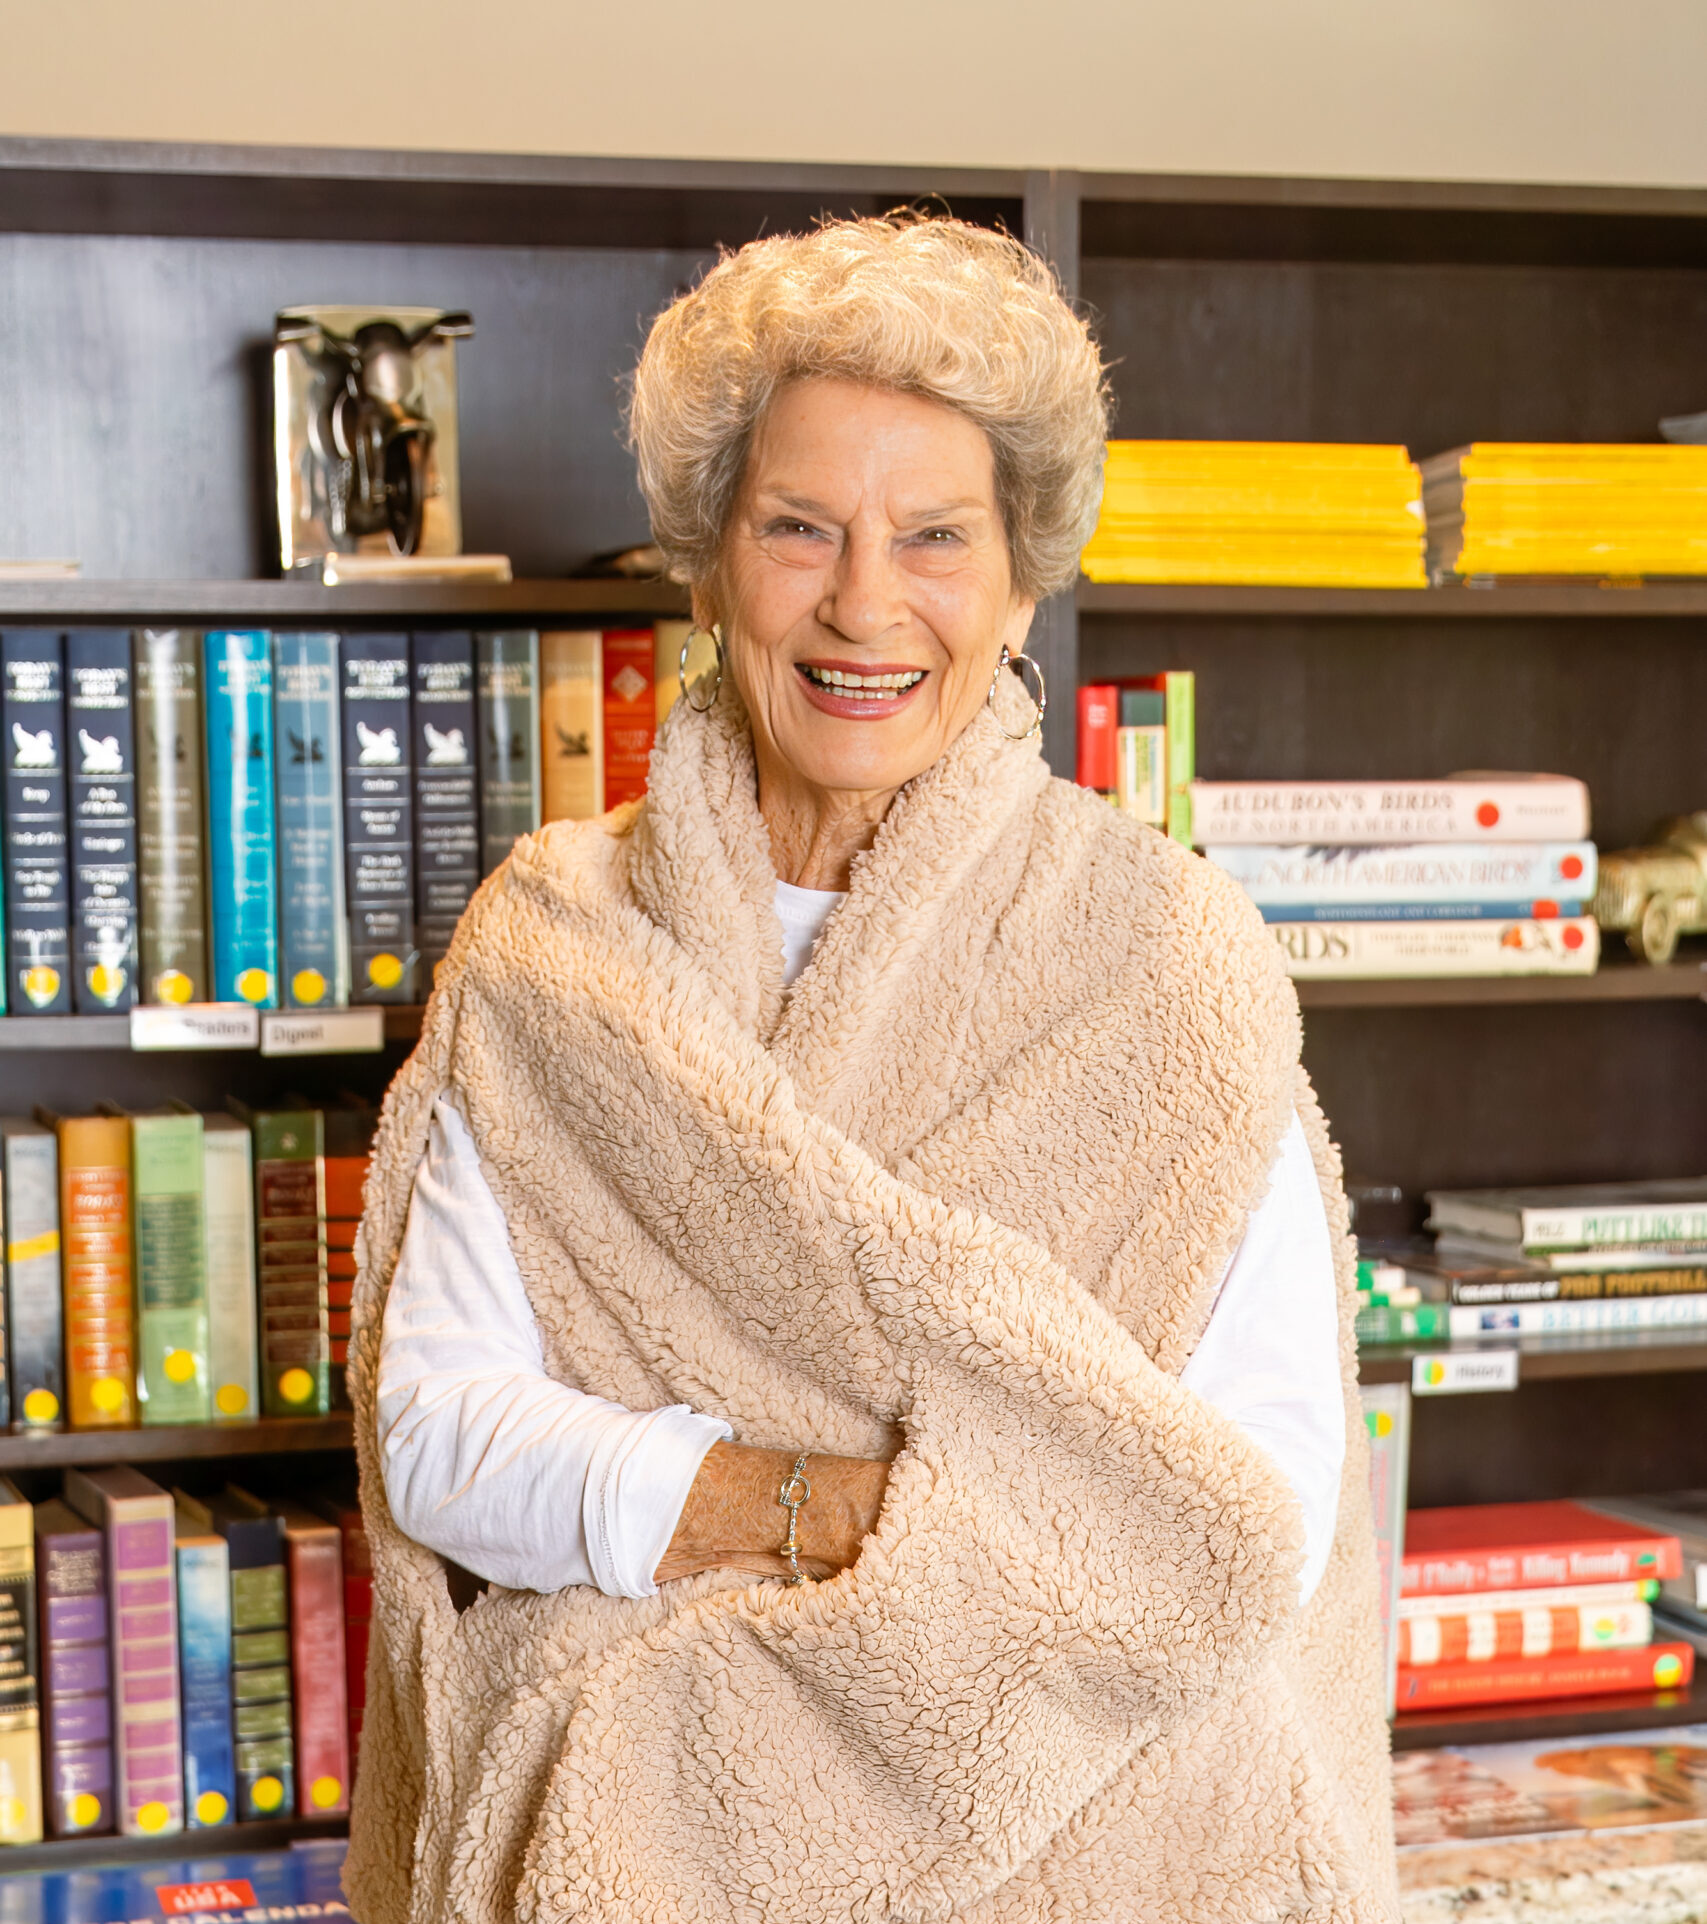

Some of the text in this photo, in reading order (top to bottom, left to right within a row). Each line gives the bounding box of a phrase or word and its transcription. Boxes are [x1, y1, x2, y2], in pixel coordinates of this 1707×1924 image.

[1214, 789, 1457, 813] AUDUBON'S BIRDS
[1249, 816, 1340, 835] NORTH
[1345, 816, 1459, 835] AMERICA
[1261, 861, 1351, 885] NORTH
[1354, 860, 1467, 885] AMERICAN
[1469, 858, 1533, 885] BIRDS
